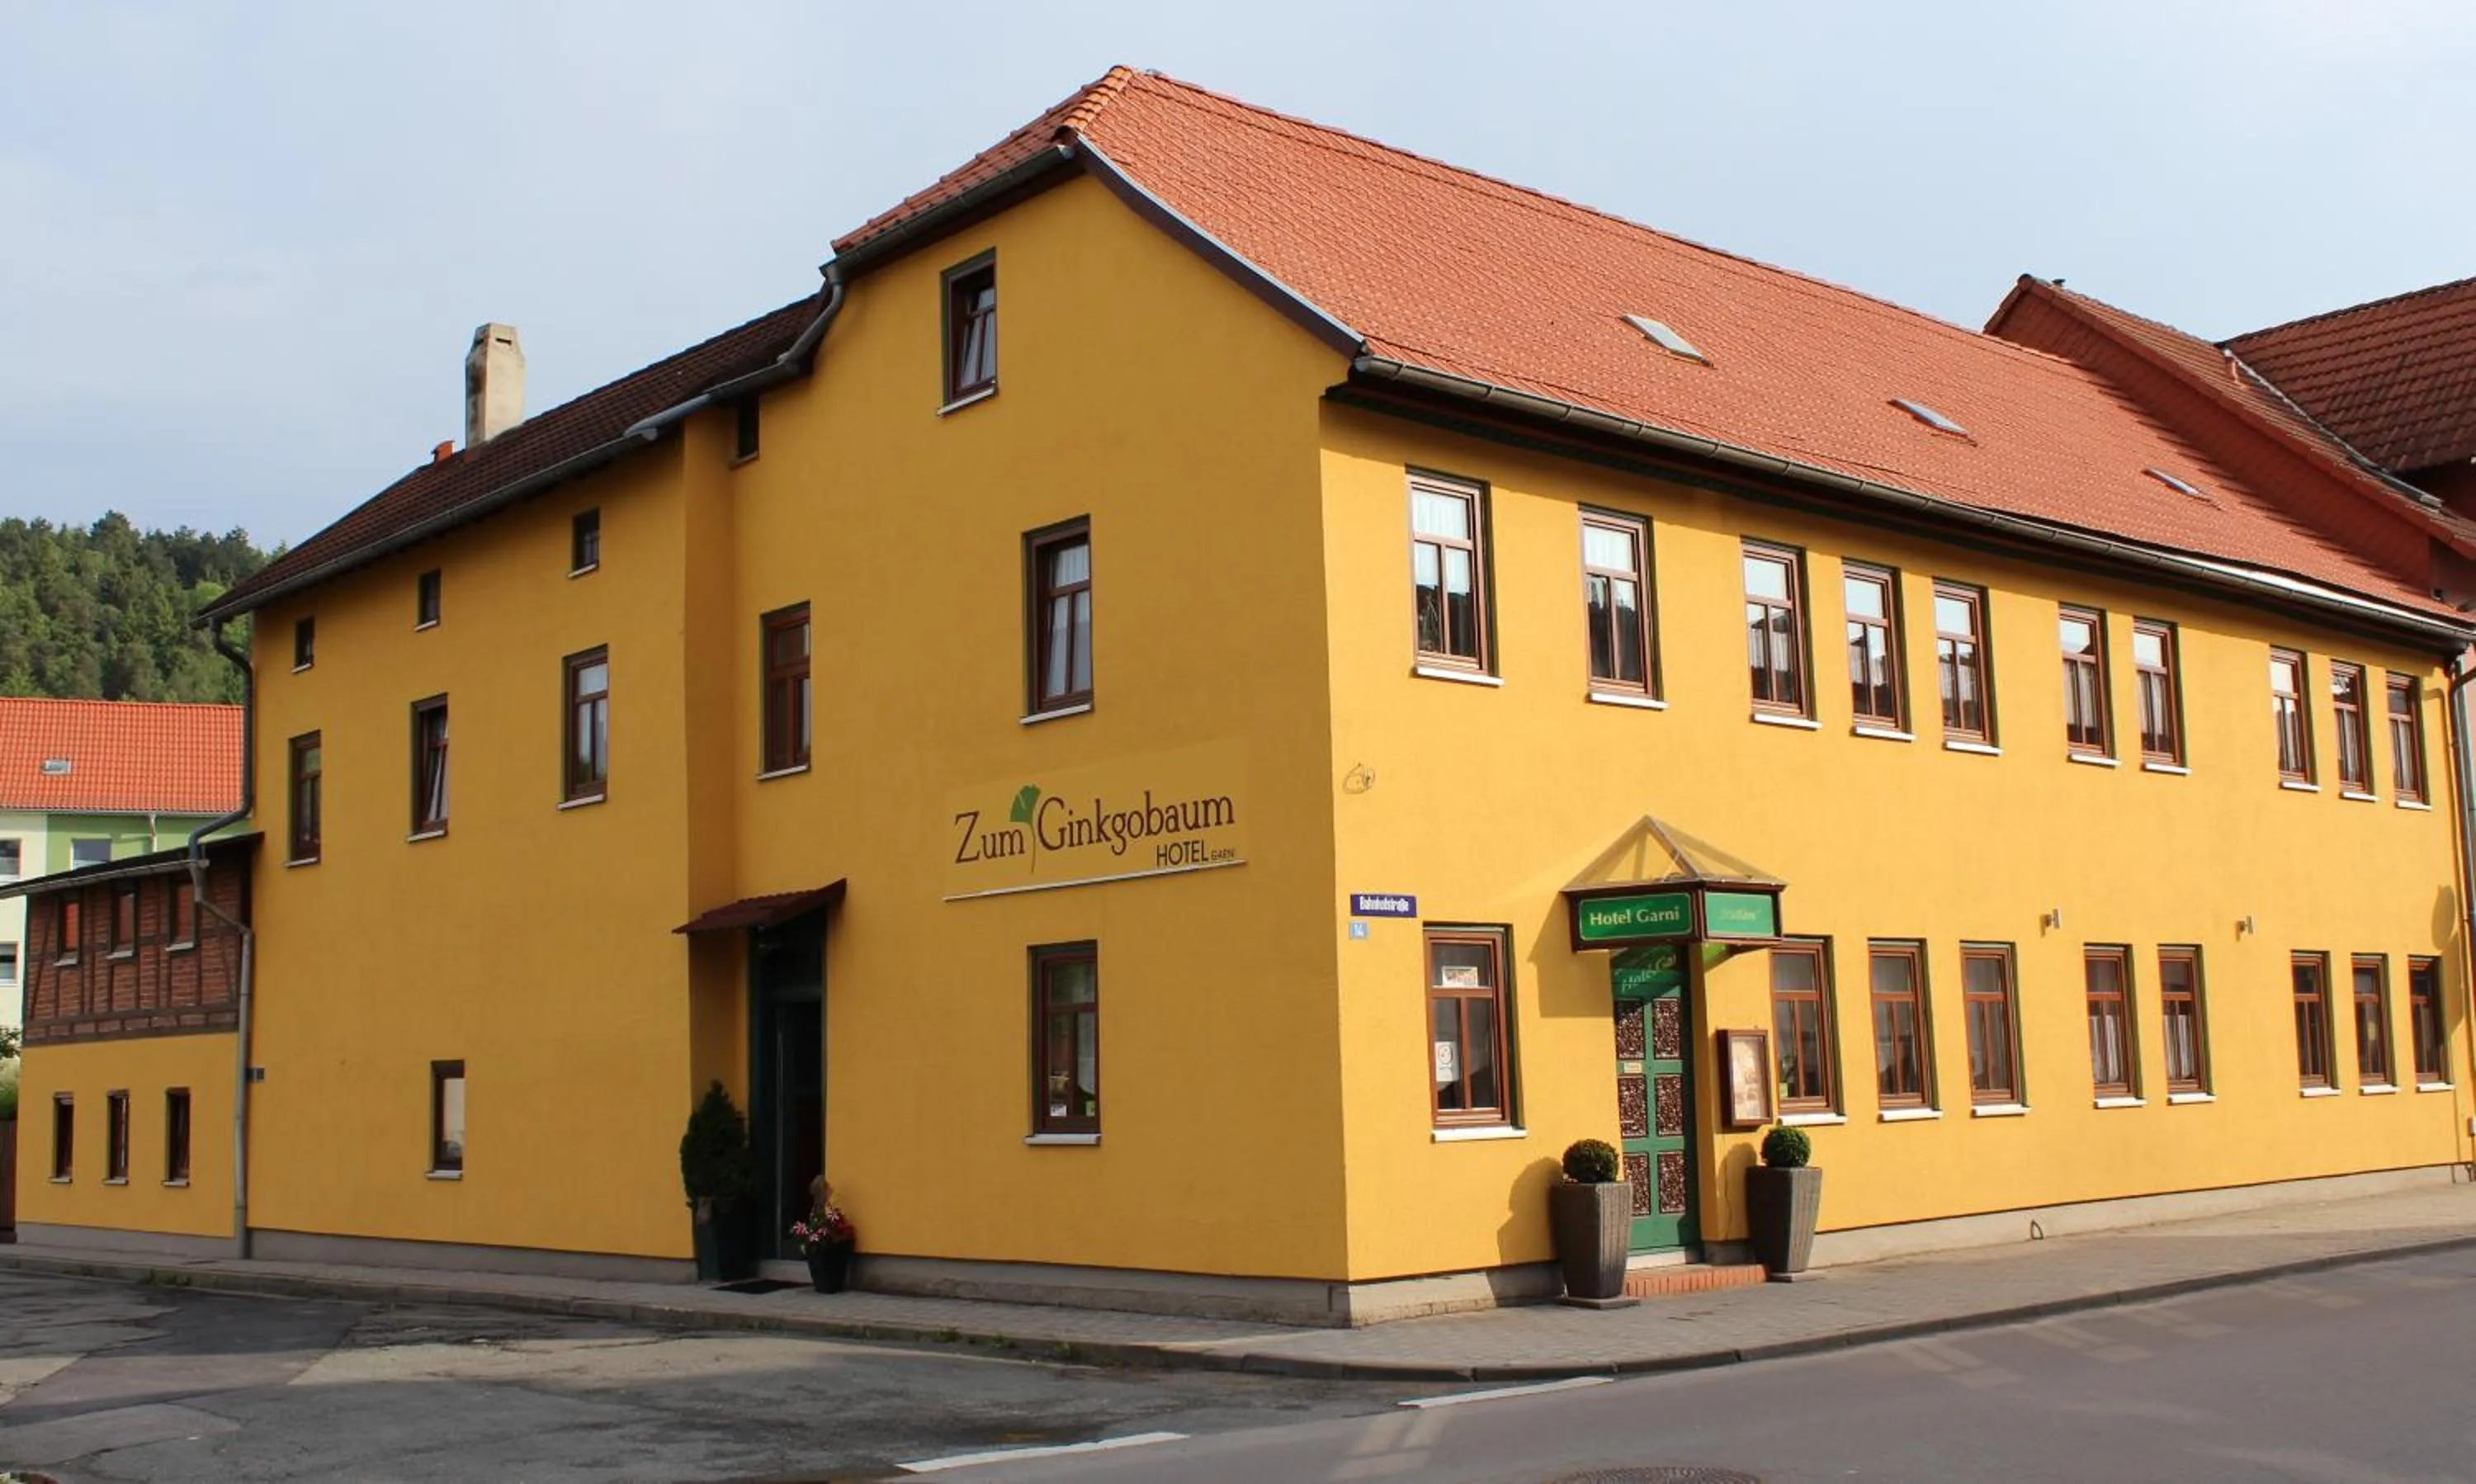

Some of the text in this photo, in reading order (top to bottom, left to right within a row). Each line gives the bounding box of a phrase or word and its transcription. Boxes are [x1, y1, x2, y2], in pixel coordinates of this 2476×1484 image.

[954, 791, 1235, 864] Zum Ginkgobaum
[1156, 839, 1208, 867] HOTEL
[1590, 905, 1680, 926] Hotel Garni
